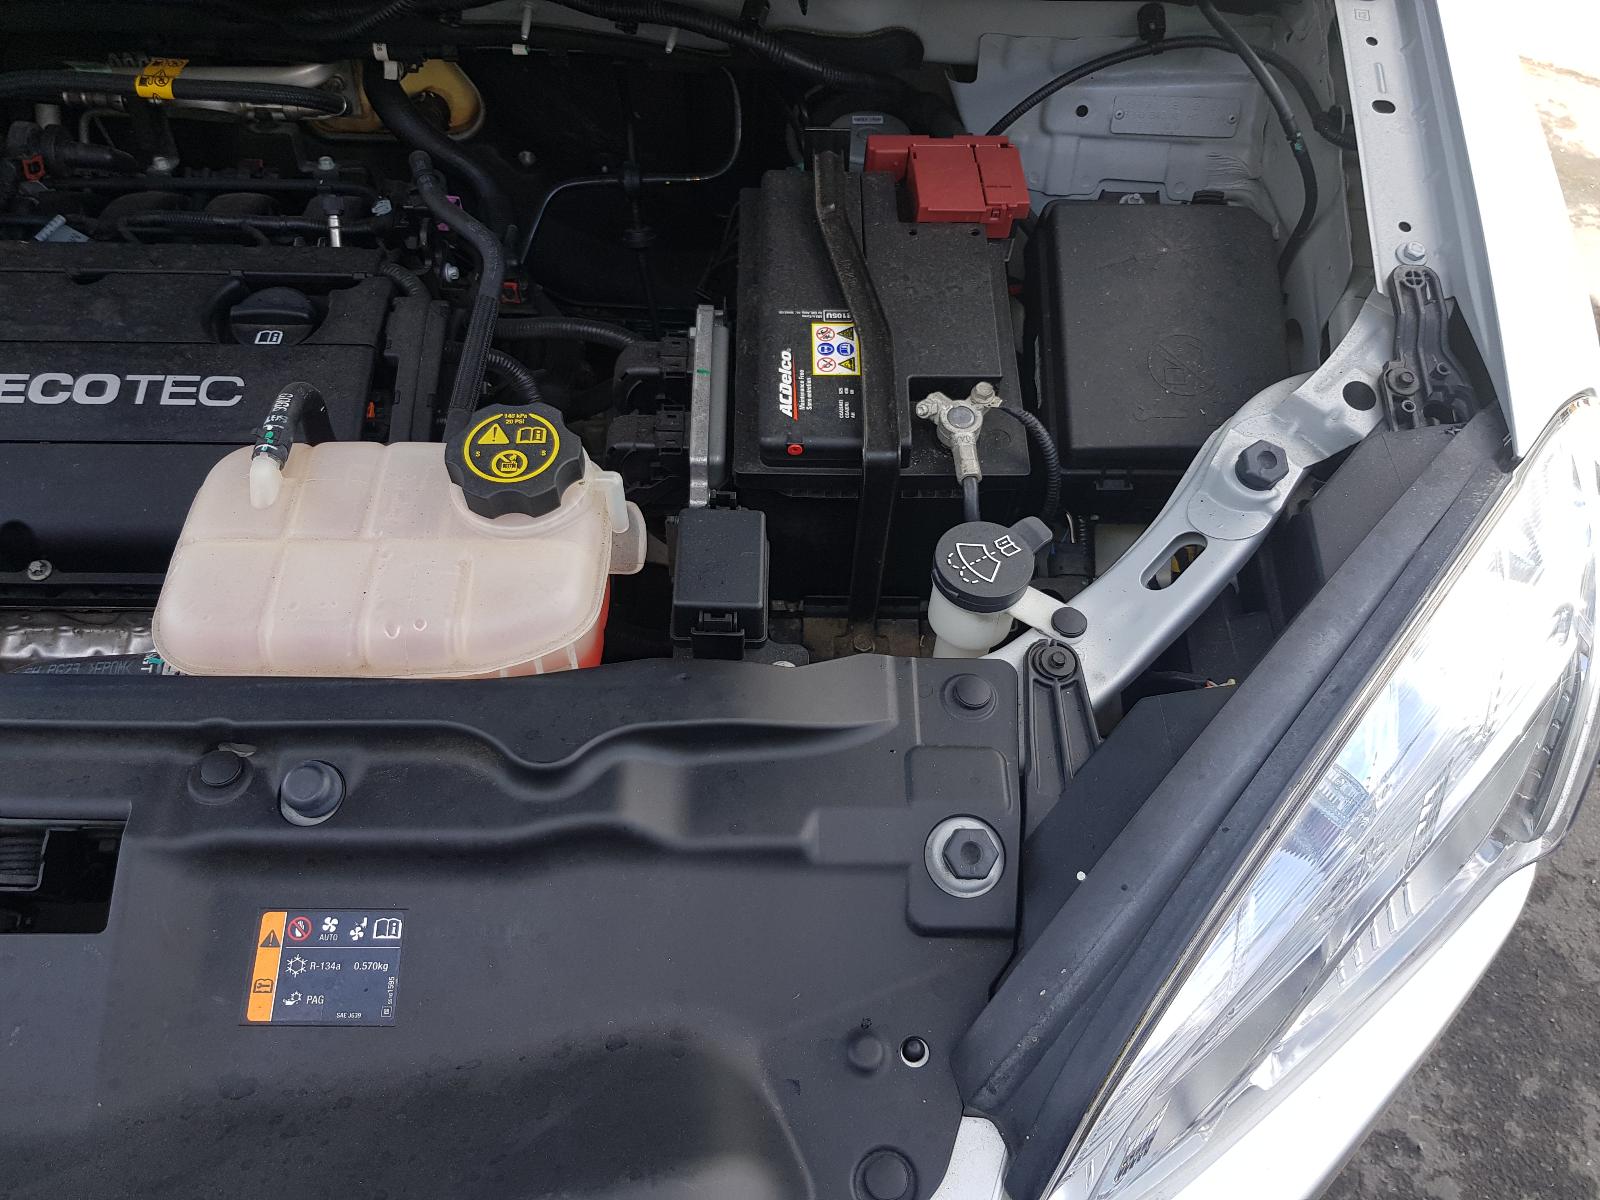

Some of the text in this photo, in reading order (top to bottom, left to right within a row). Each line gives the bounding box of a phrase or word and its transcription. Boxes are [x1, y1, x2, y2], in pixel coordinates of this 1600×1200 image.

[0, 373, 246, 407] ECOTEC
[318, 933, 339, 941] AUTO
[309, 961, 389, 972] R-134a 0.570kg
[306, 994, 325, 1005] PAG
